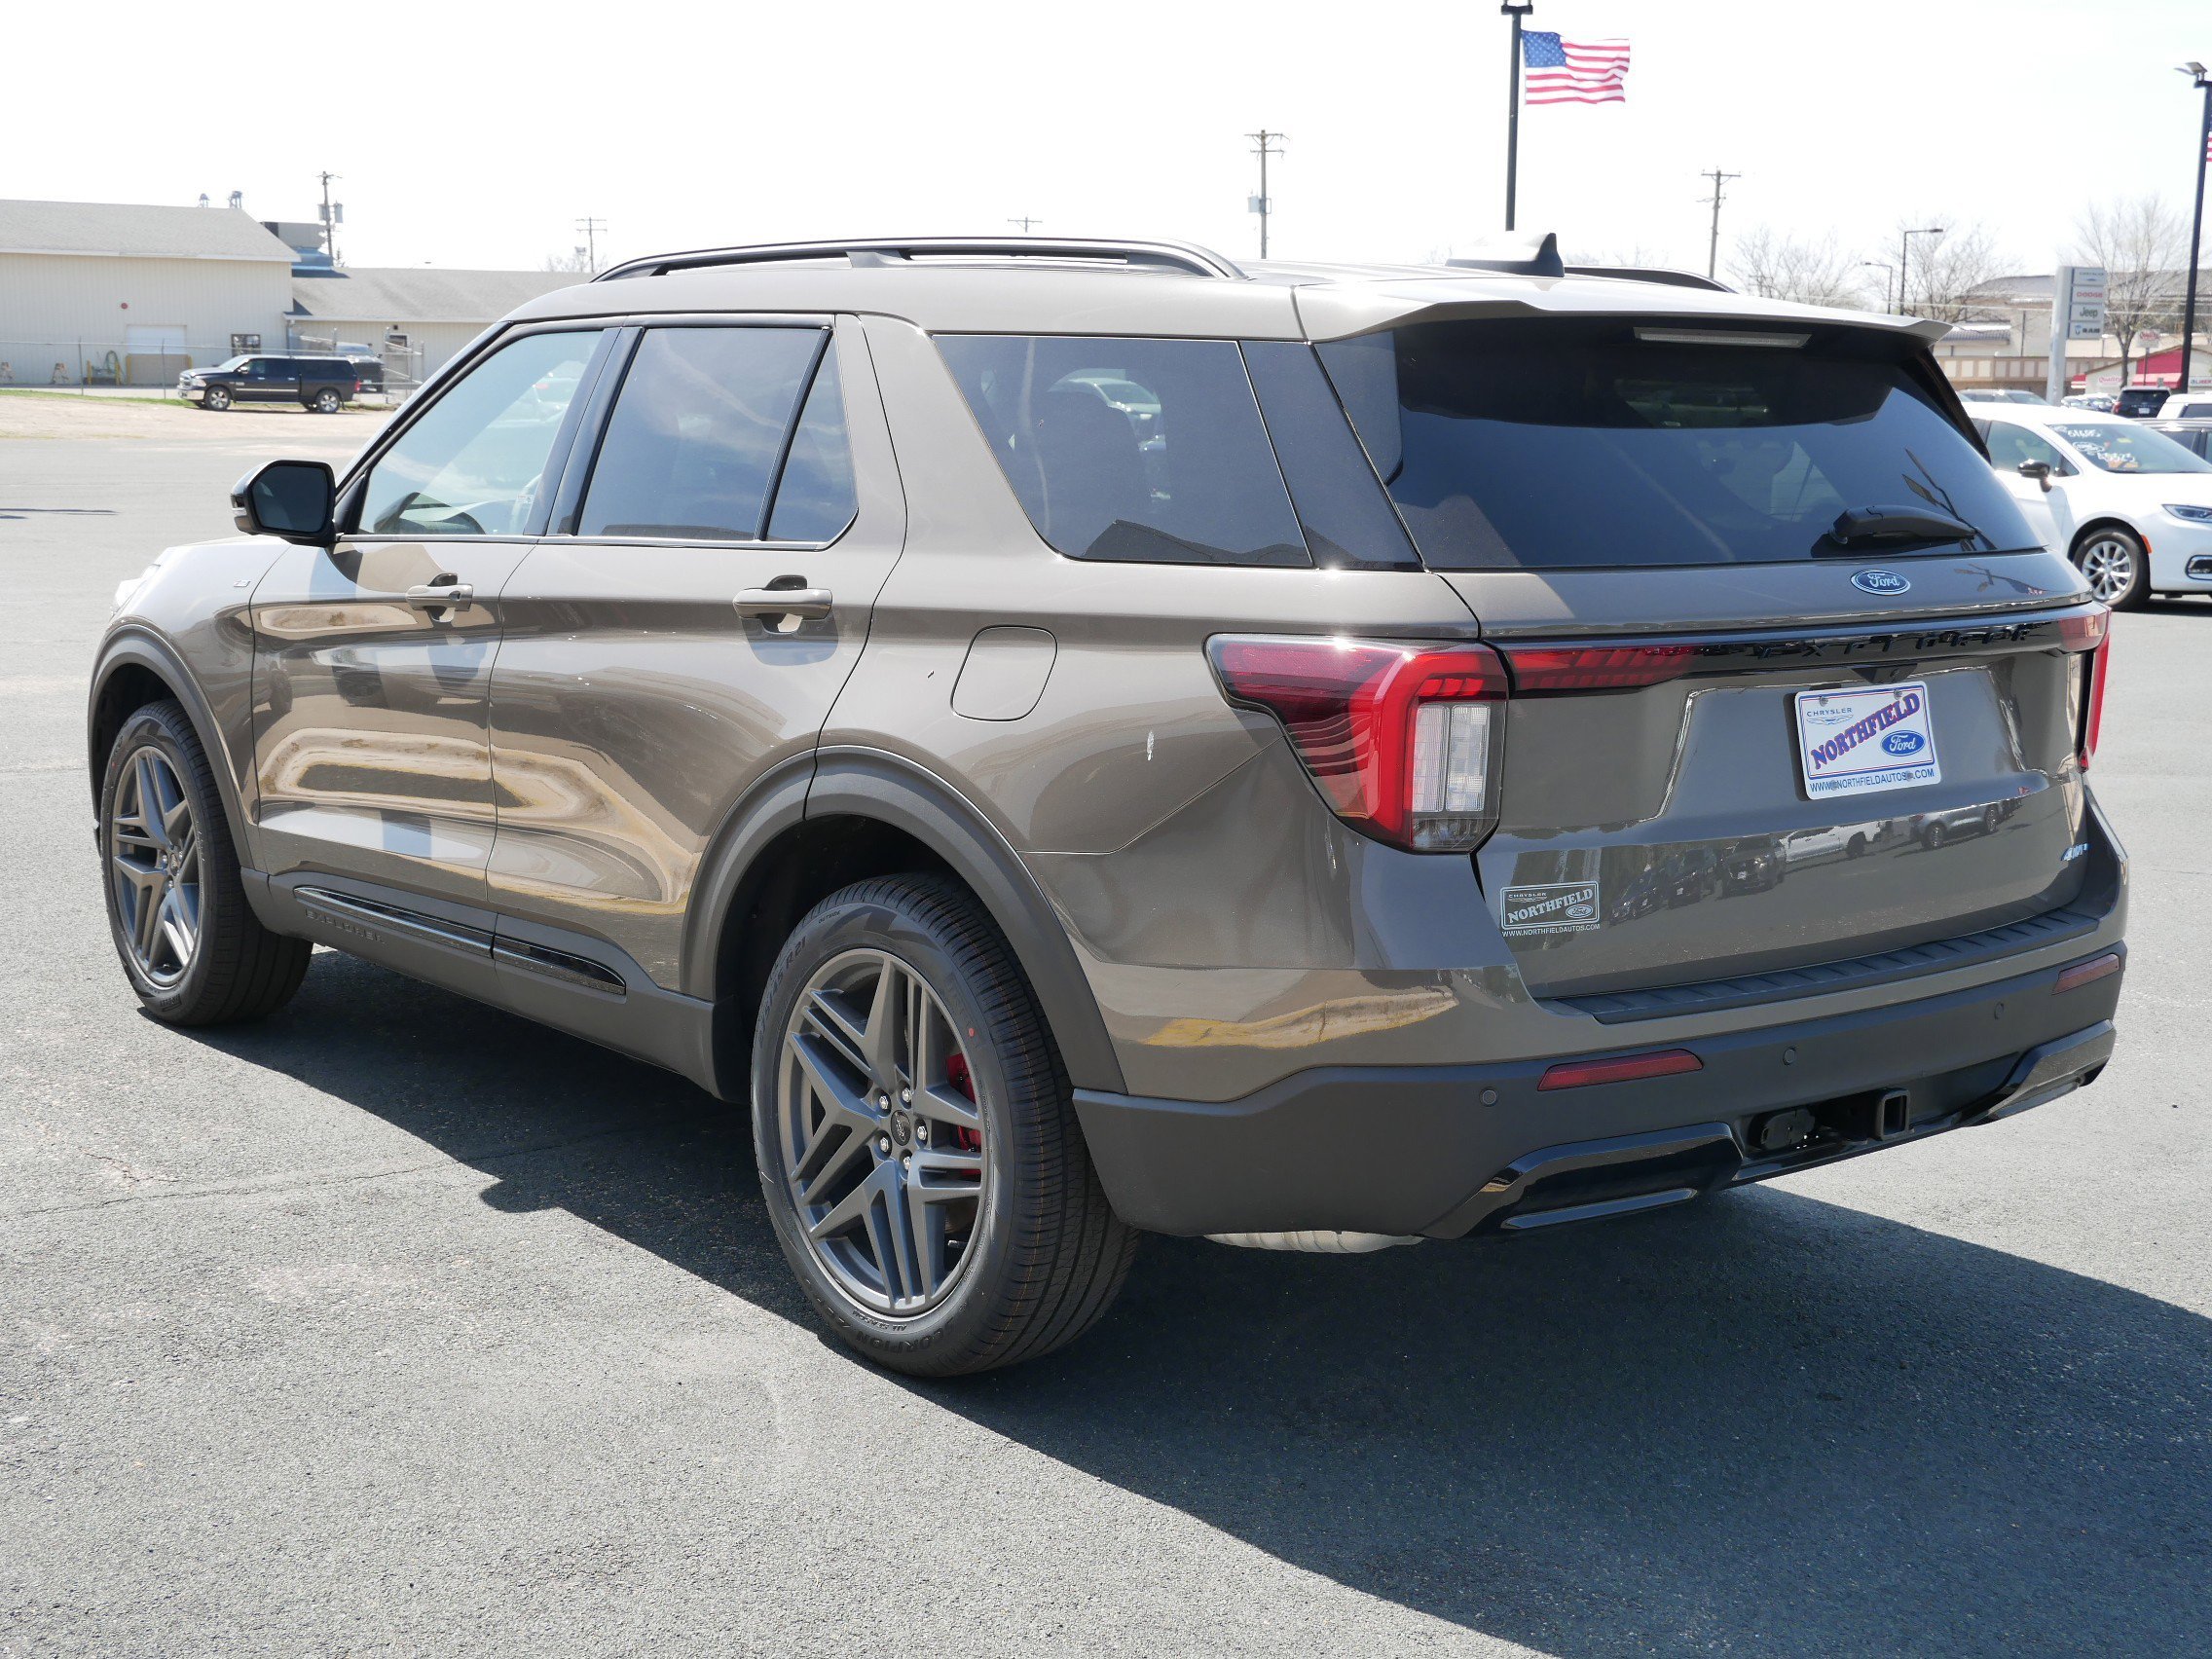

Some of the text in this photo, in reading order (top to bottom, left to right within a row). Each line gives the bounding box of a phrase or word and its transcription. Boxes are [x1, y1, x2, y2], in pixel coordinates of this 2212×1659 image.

[2080, 307, 2098, 318] Jeep
[1866, 572, 1900, 588] Ford
[1806, 707, 1853, 718] CHRYSLER
[1810, 692, 1921, 770] NORTHFIELD
[1889, 734, 1917, 752] Ford
[1507, 888, 1593, 924] NORTHFIELD
[1501, 923, 1601, 938] WWW.NORTHFIELDAUTOS.COM
